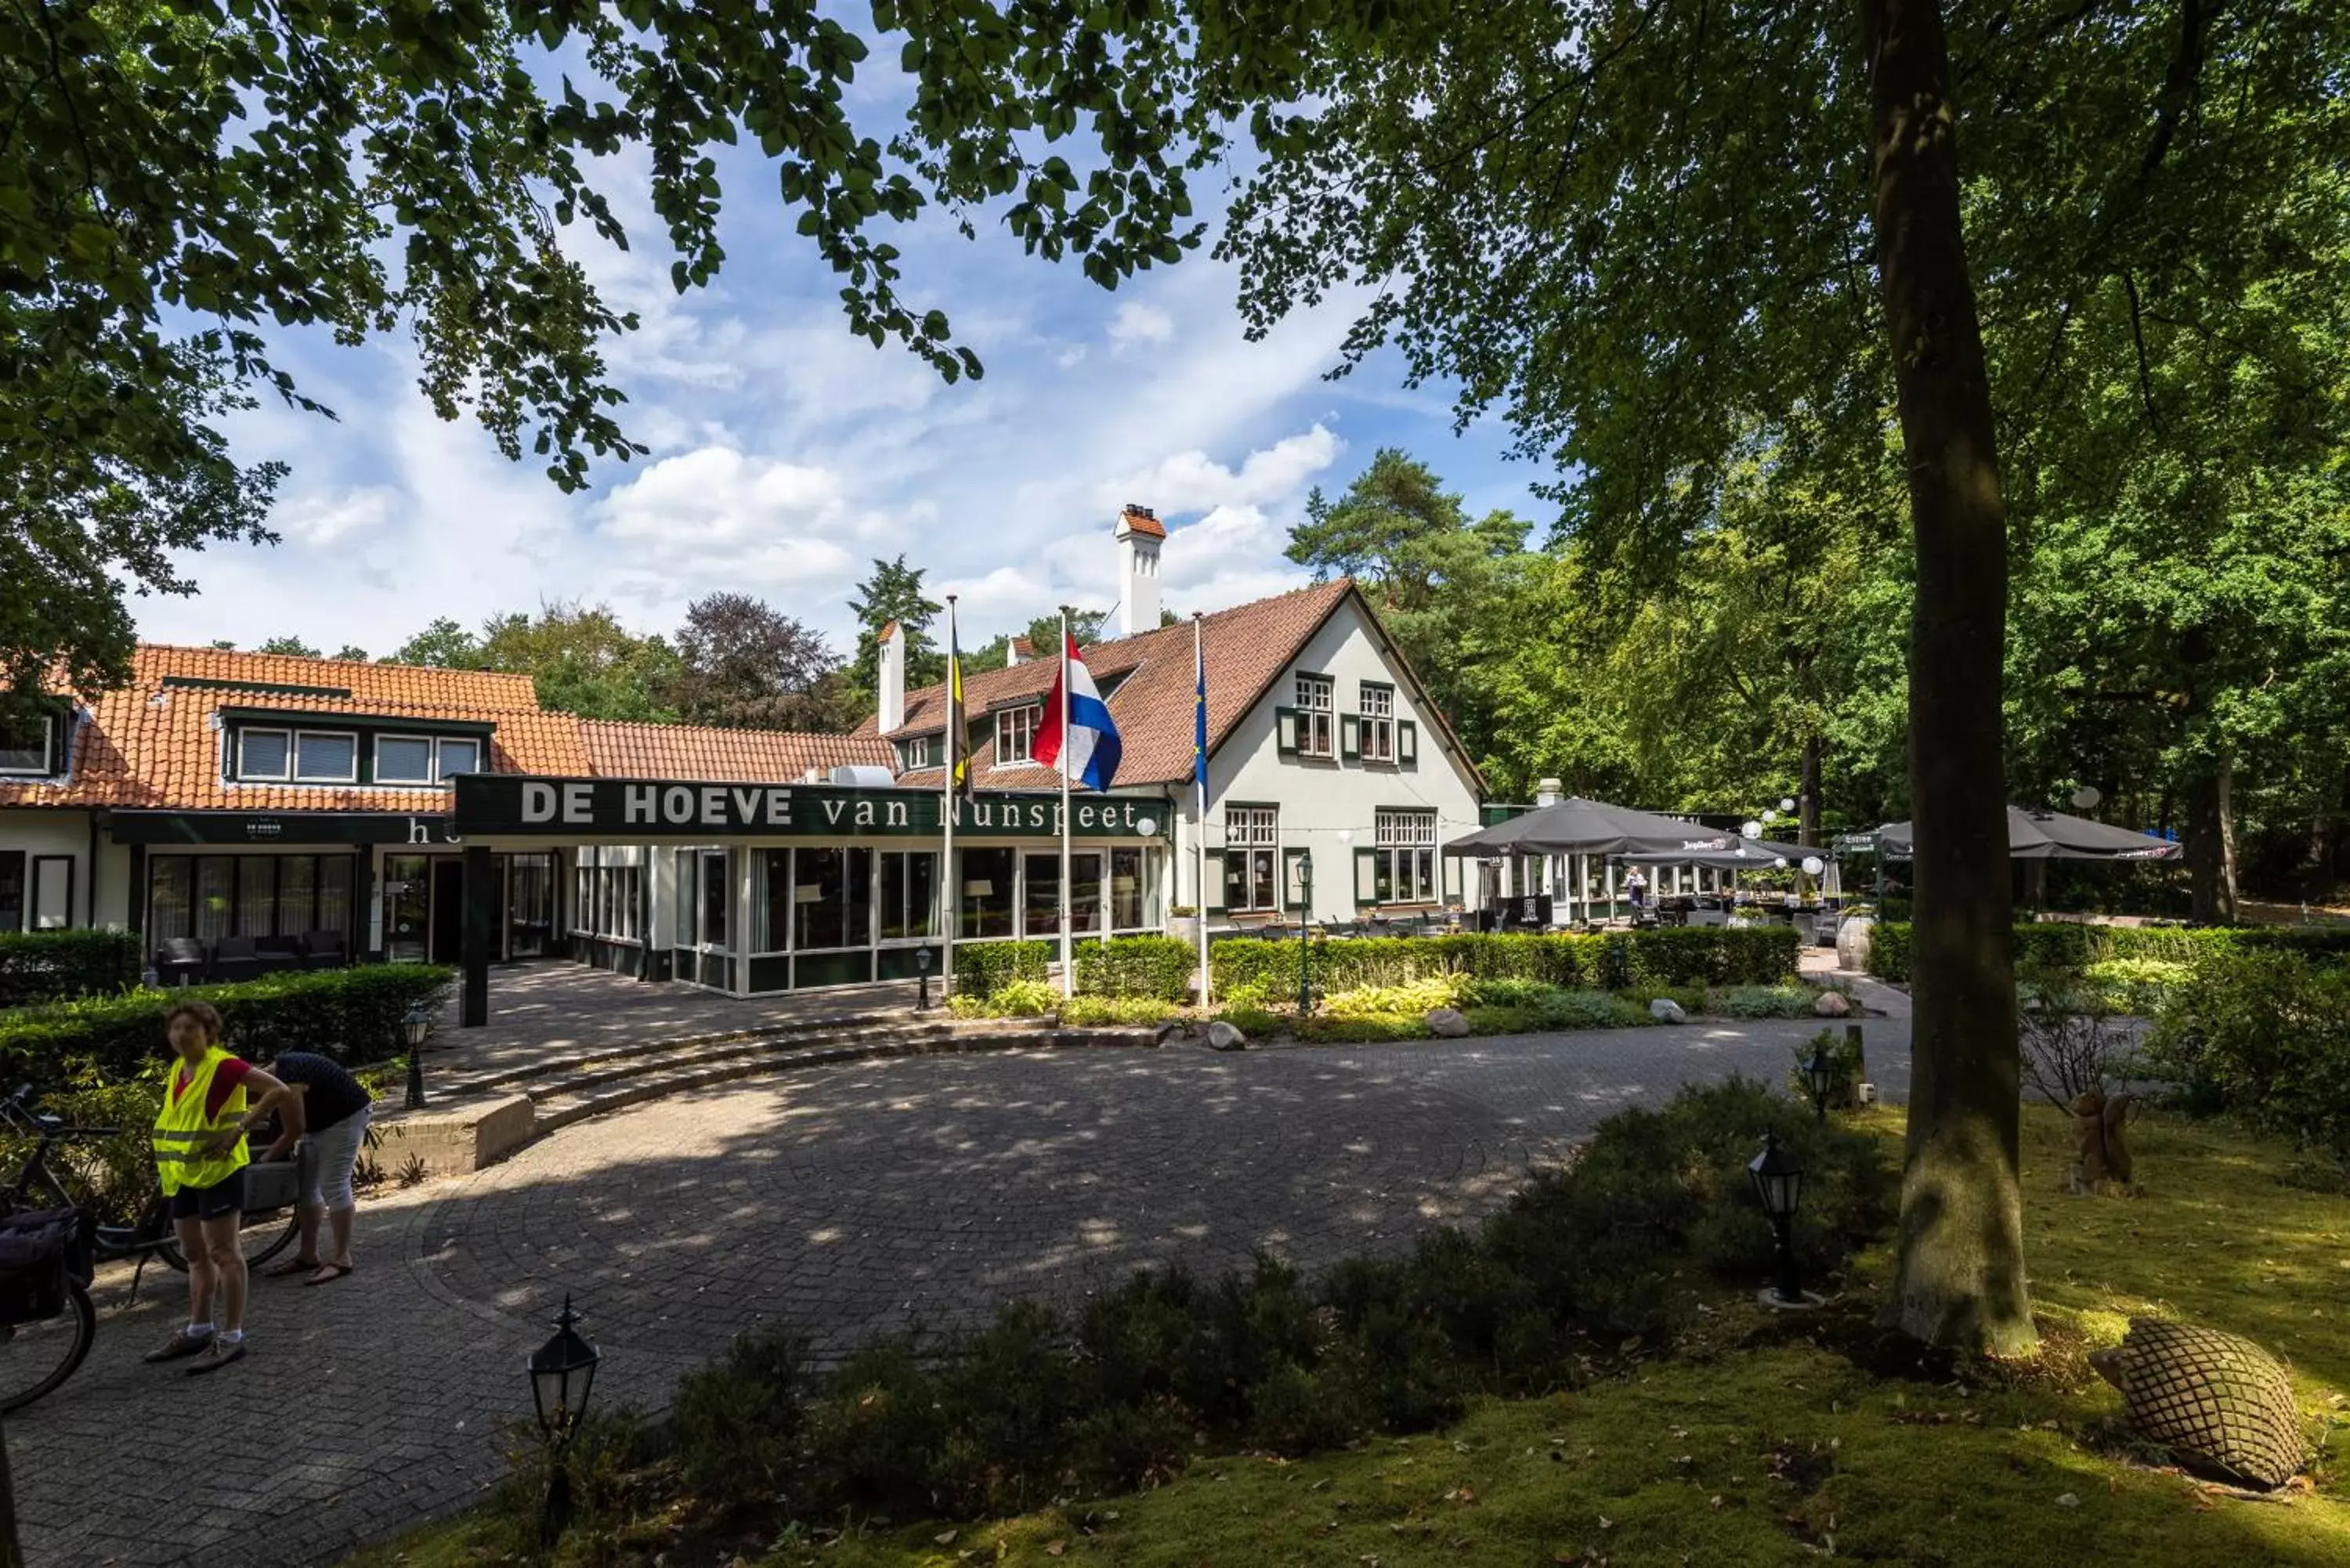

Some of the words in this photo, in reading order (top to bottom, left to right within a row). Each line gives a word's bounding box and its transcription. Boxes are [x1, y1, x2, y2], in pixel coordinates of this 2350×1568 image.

[521, 782, 595, 823] DE
[624, 783, 792, 825] HOEVE
[822, 800, 909, 826] van
[938, 794, 1136, 836] Nunspeet
